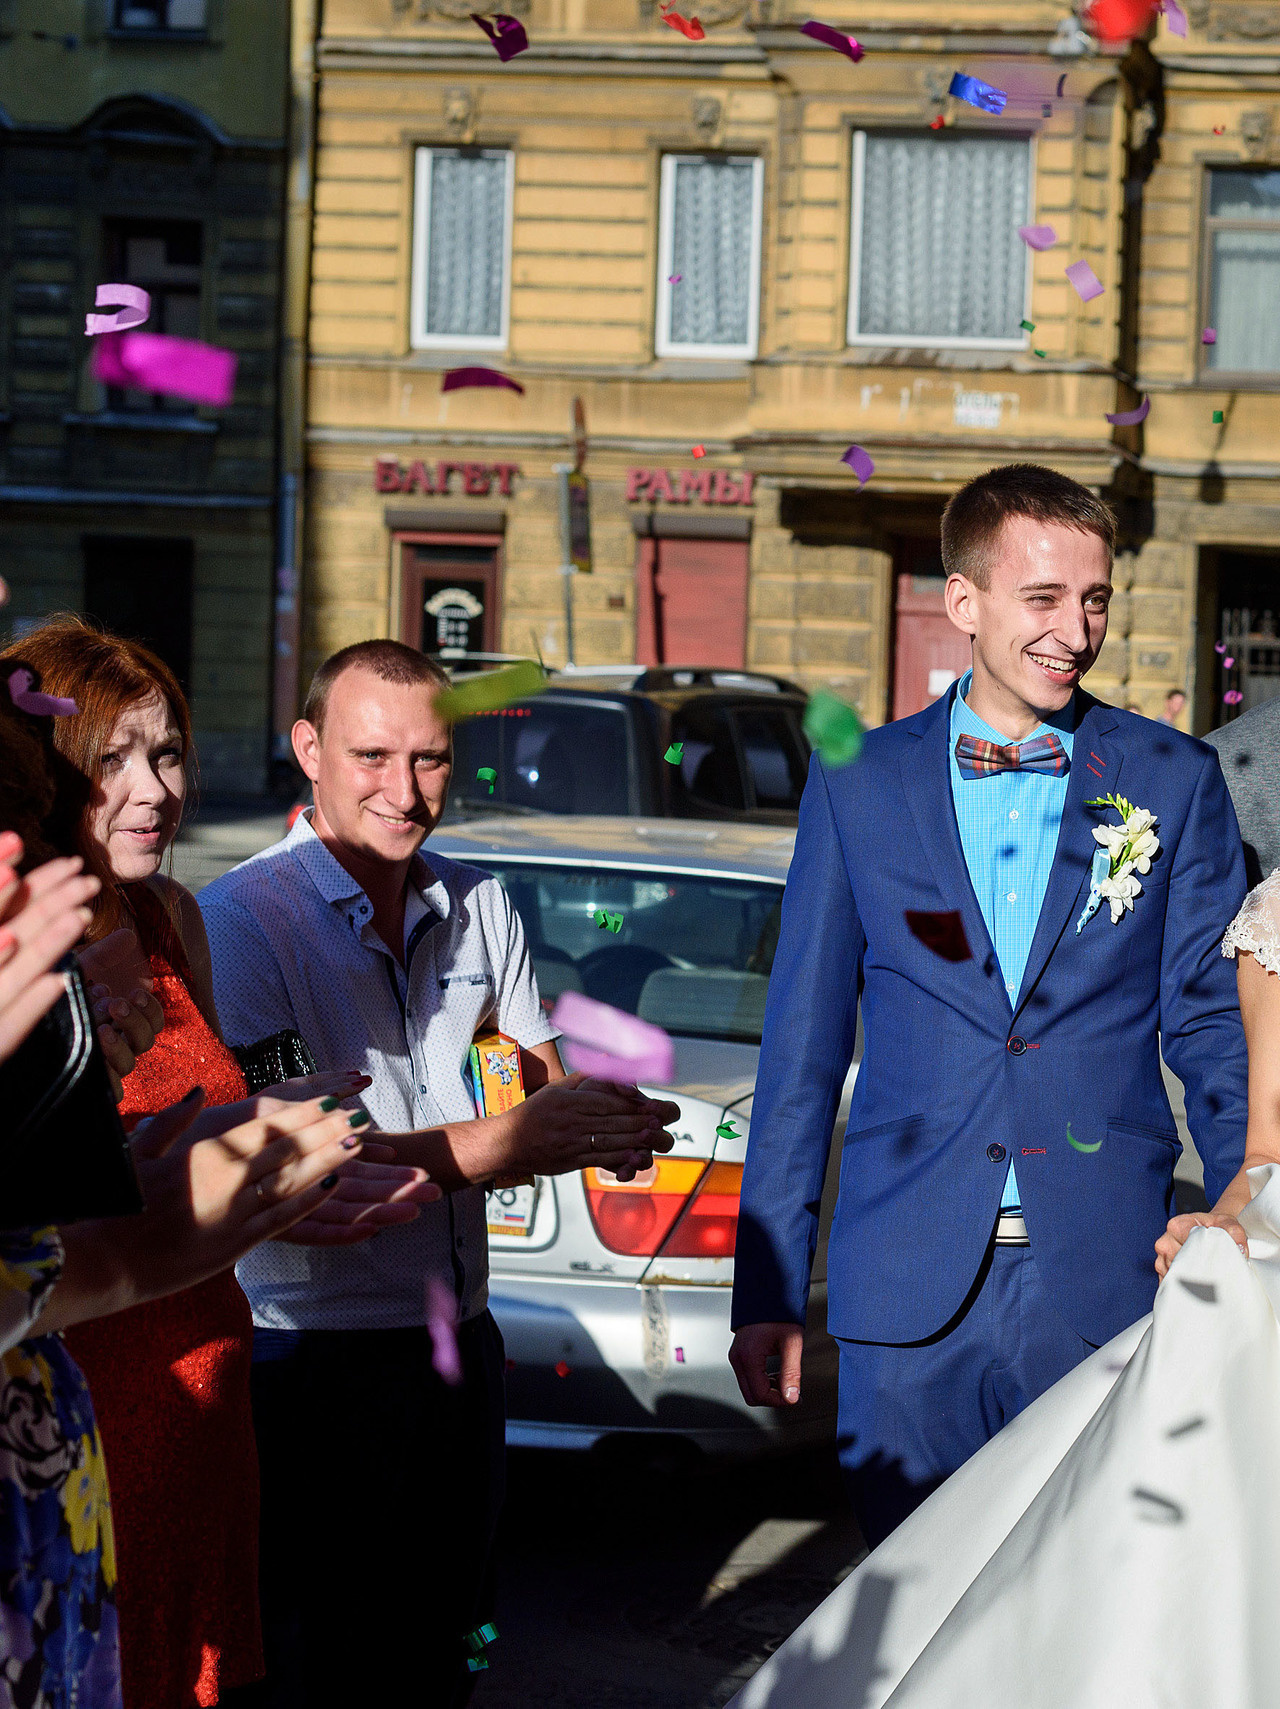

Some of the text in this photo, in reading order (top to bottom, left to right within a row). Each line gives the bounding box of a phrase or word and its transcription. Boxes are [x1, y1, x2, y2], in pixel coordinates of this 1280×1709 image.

[374, 459, 520, 496] БАГЕТ
[626, 467, 755, 505] РАМЫ
[497, 1088, 506, 1113] ВАЙТЕ
